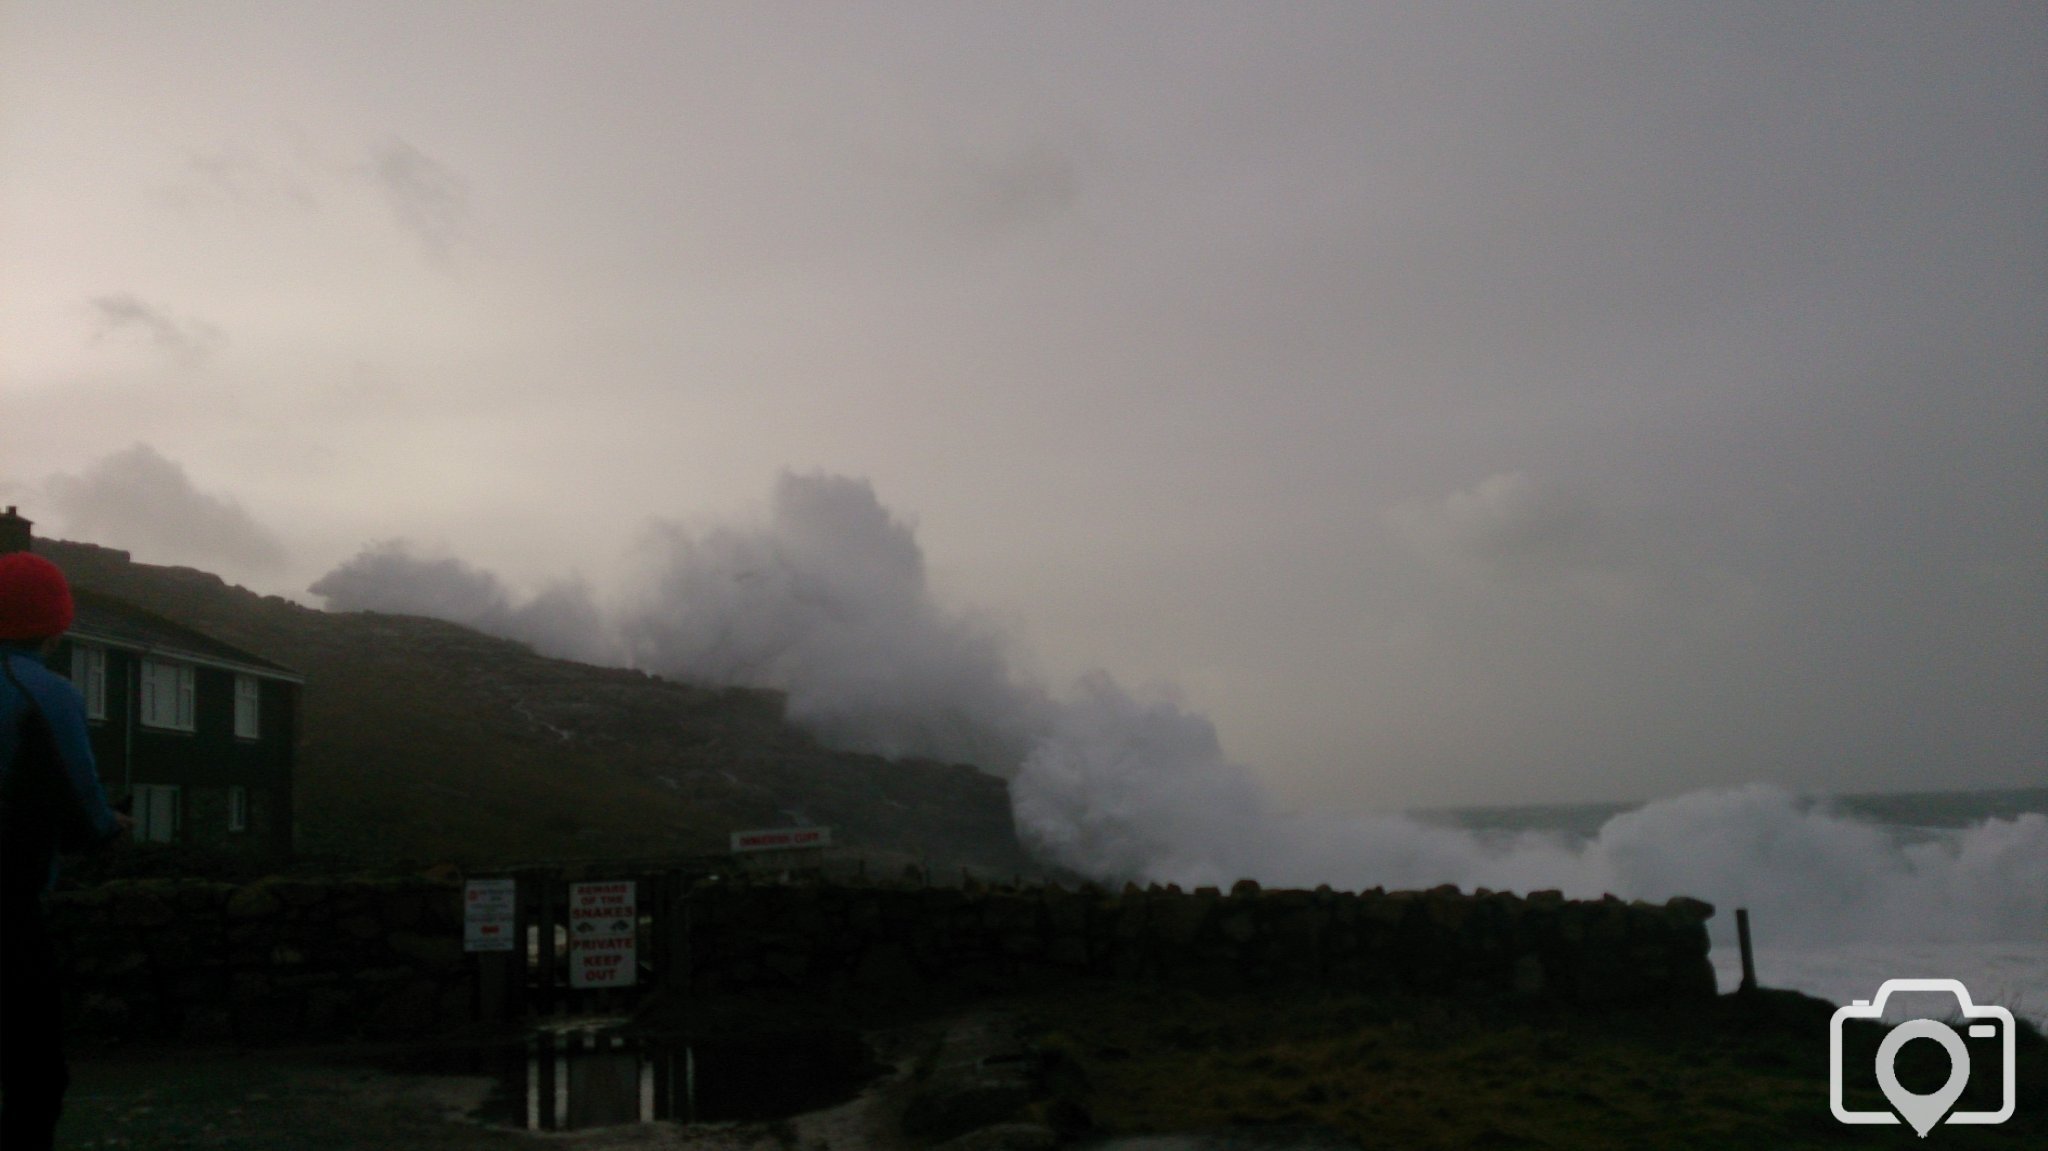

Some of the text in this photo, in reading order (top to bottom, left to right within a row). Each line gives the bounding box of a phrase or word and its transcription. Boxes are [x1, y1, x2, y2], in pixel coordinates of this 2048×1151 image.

[577, 885, 627, 895] BEWARE
[581, 895, 624, 905] OF THE
[572, 907, 633, 918] SNAKES
[572, 938, 633, 950] PRIVATE
[583, 955, 622, 966] KEEP
[585, 969, 617, 981] OUT
